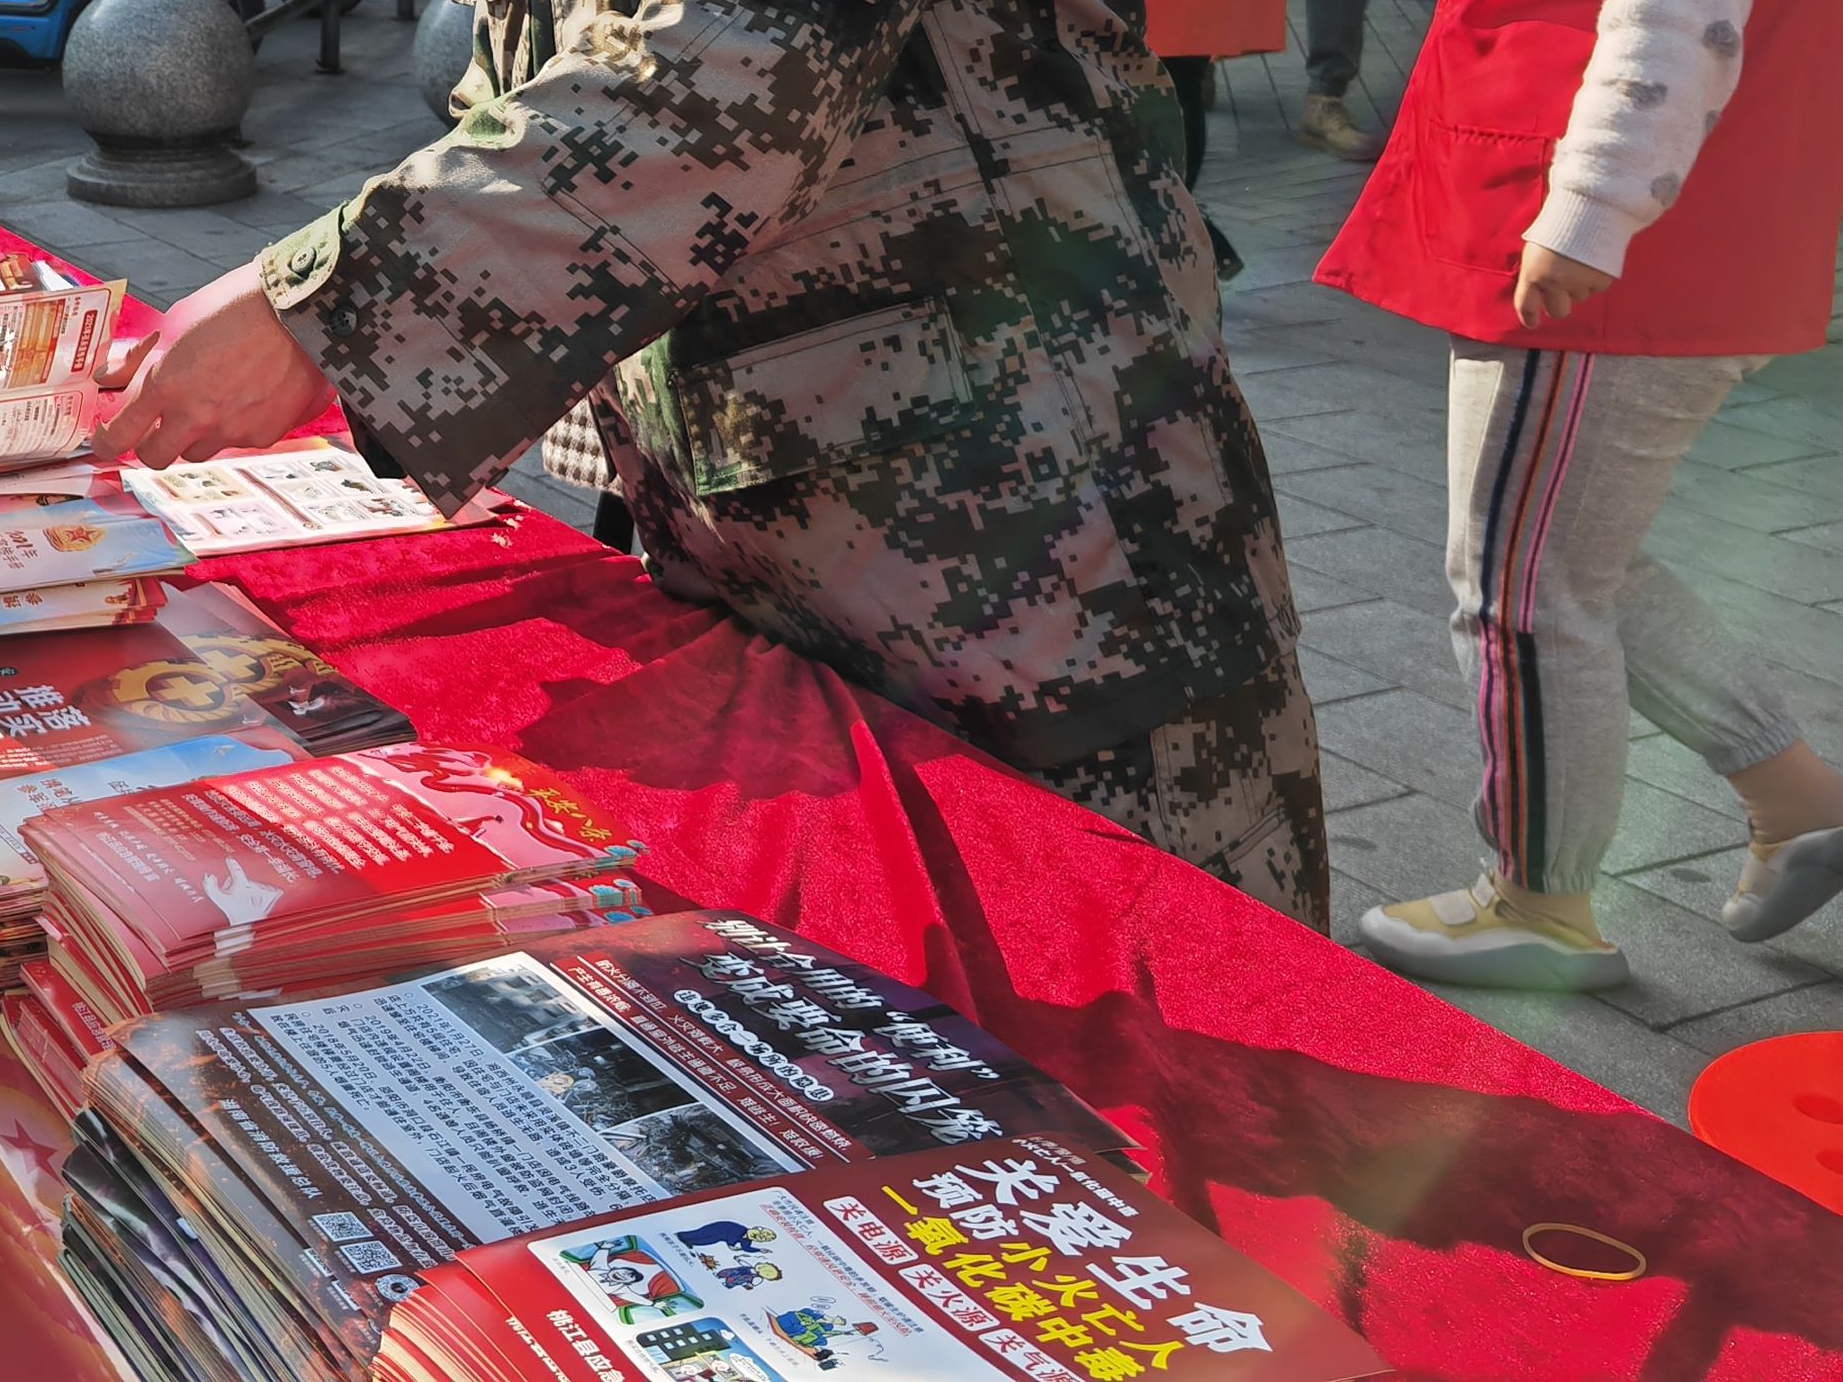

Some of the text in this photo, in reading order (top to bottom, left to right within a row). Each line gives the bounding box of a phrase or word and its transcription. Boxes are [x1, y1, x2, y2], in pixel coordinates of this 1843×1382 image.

[529, 785, 612, 844] 平安八条
[669, 989, 840, 1101] 违规多合一场所的隐患
[678, 947, 1014, 1148] 变成要命的囚笼
[216, 1098, 324, 1198] 湖南省消防救援总队
[837, 1200, 906, 1262] 关电源
[908, 1266, 991, 1331] 关火源
[880, 1185, 1146, 1381] 一氧化碳中毒
[913, 1171, 1185, 1371] 预防小火亡人
[954, 1158, 1274, 1354] 关爱生命
